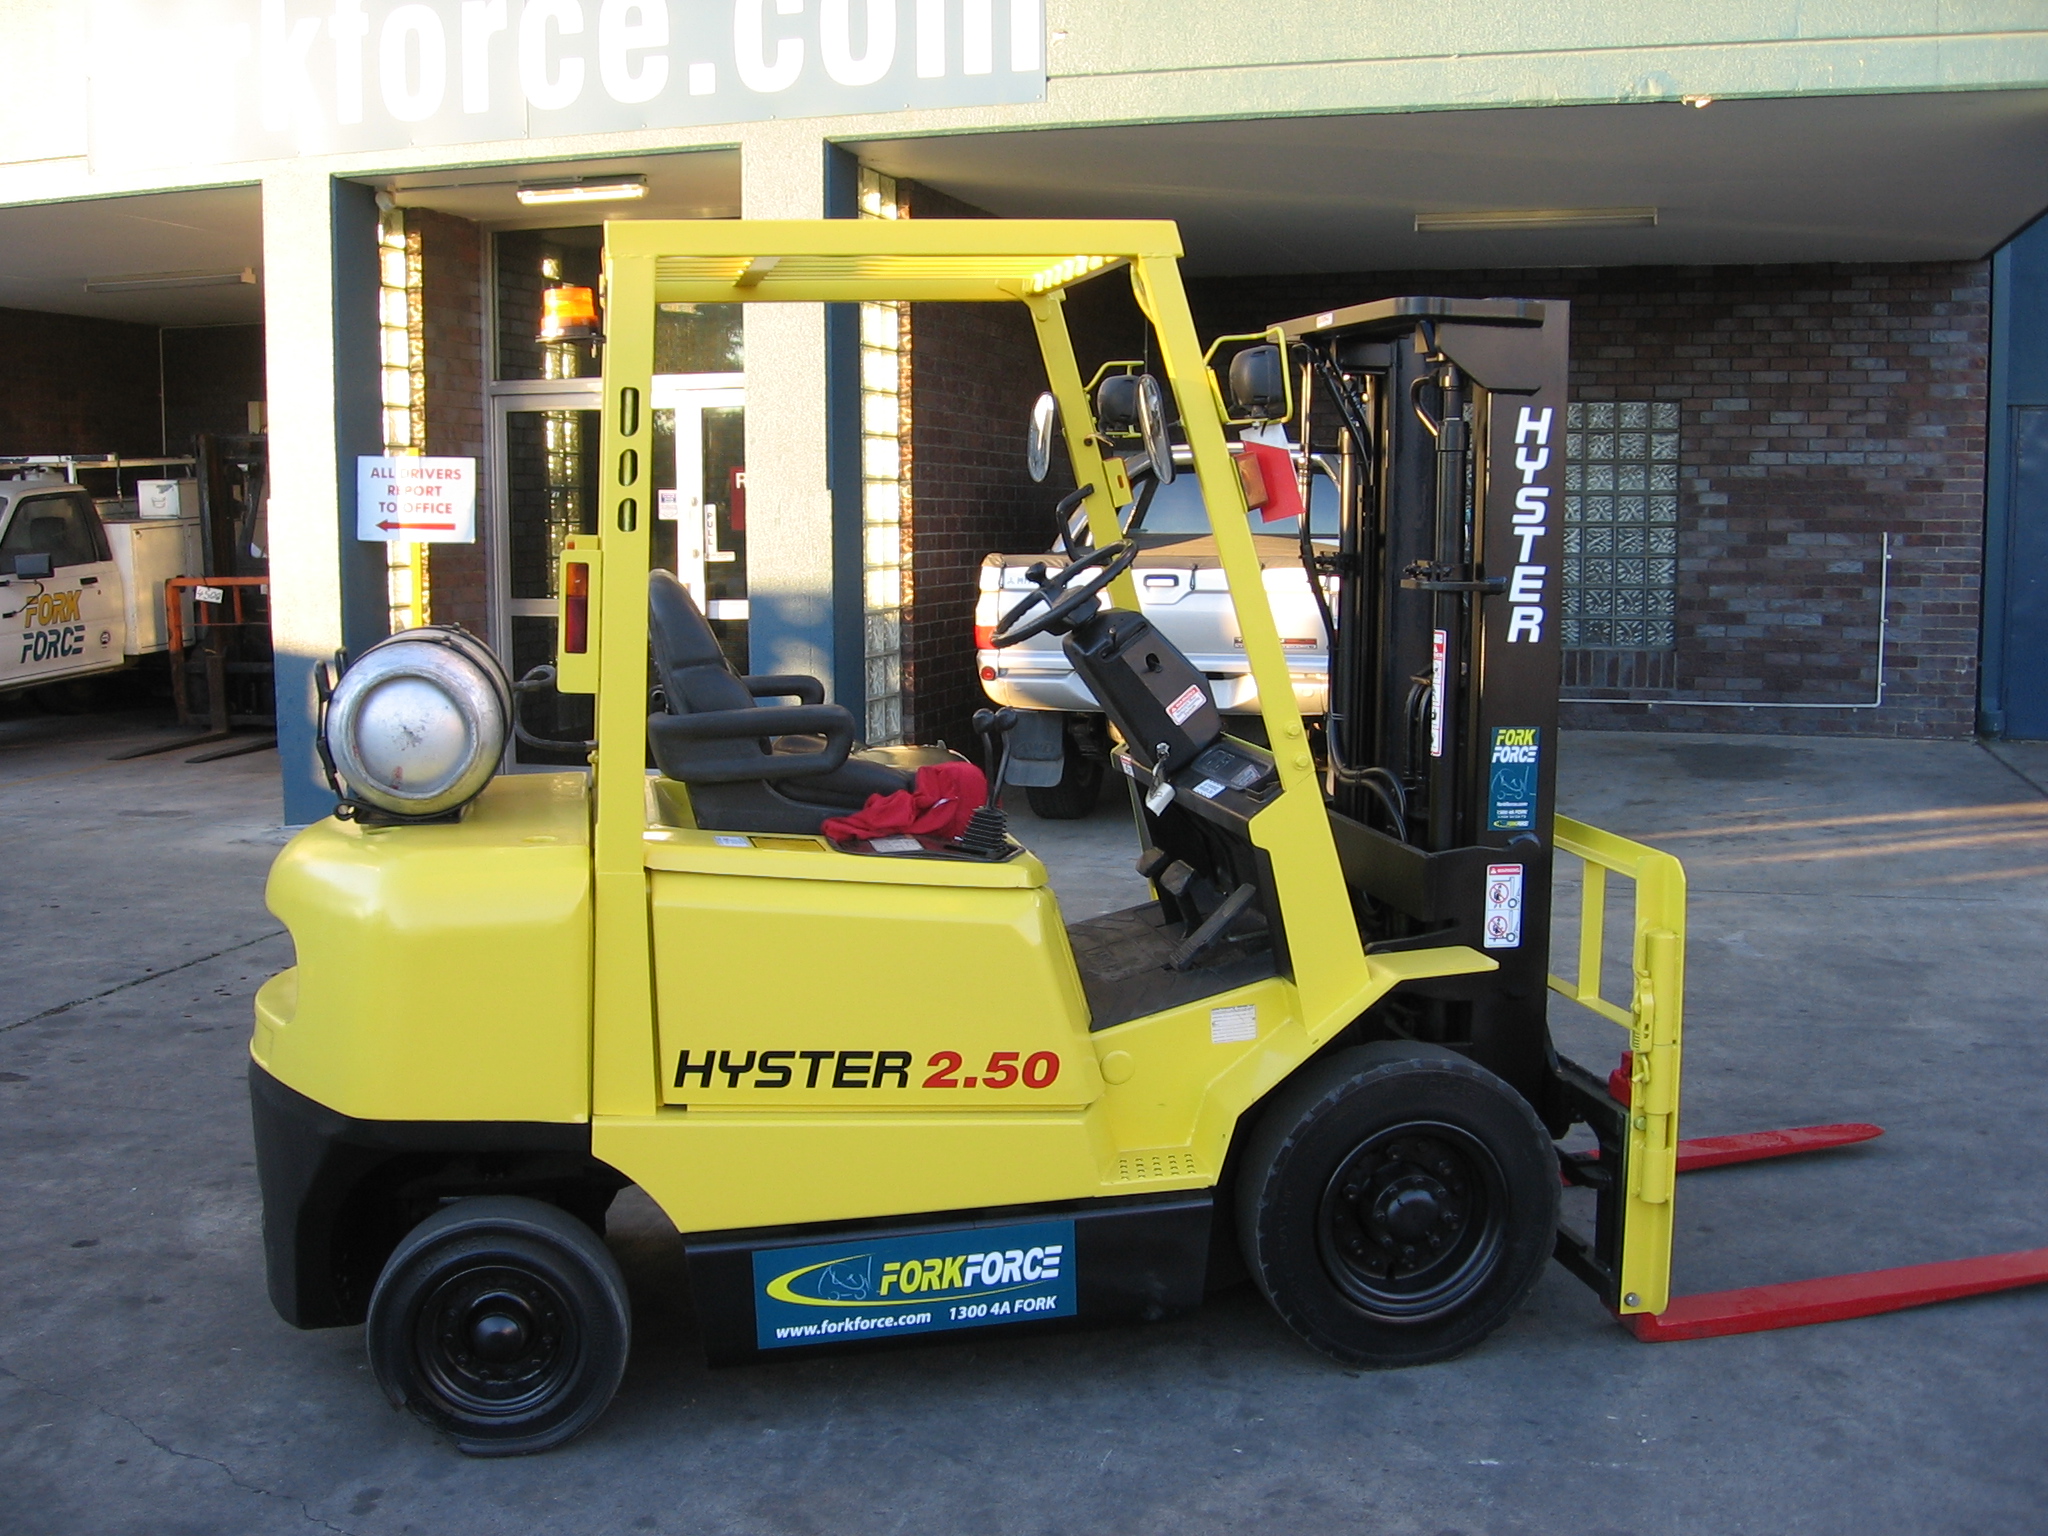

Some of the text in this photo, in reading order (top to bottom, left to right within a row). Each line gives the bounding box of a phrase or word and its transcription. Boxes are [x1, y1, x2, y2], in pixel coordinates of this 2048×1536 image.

[370, 467, 462, 480] ALL DRIVERS
[387, 485, 442, 497] REPORT
[379, 502, 452, 514] TO OFFICE
[1507, 407, 1553, 643] HYSTER
[25, 590, 82, 628] FORK
[20, 625, 85, 664] FORCE
[1496, 729, 1536, 745] FORK
[1492, 746, 1538, 763] FORCE
[674, 1050, 1061, 1088] HYSTER 2.50
[776, 1295, 1057, 1339] www.forkforce.com 1300 4A FORK
